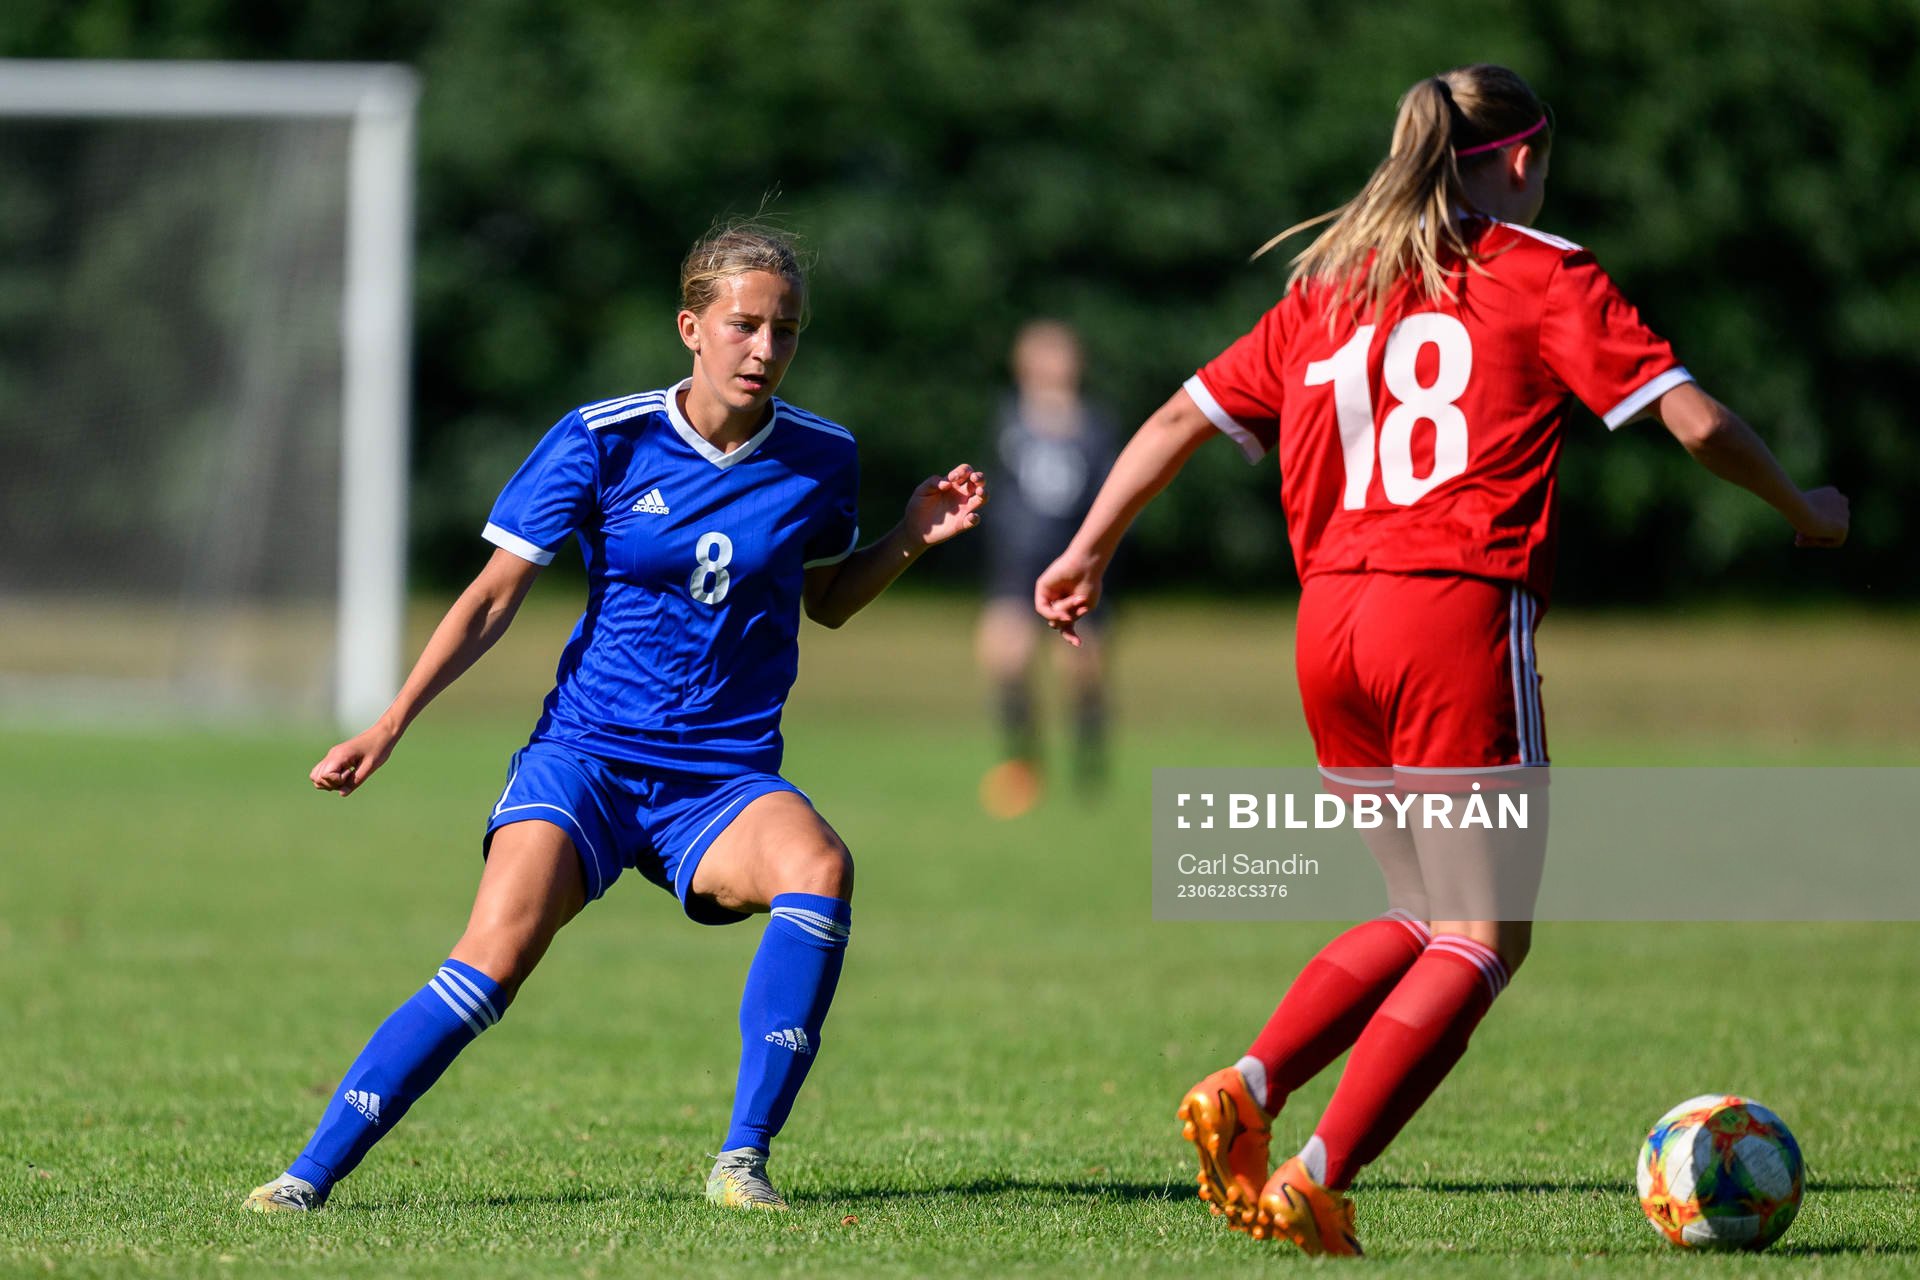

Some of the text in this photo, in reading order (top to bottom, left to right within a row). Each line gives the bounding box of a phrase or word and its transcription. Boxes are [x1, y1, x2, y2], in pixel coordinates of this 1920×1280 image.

[1304, 312, 1473, 510] 18
[632, 503, 670, 515] adidas
[690, 531, 733, 605] 8
